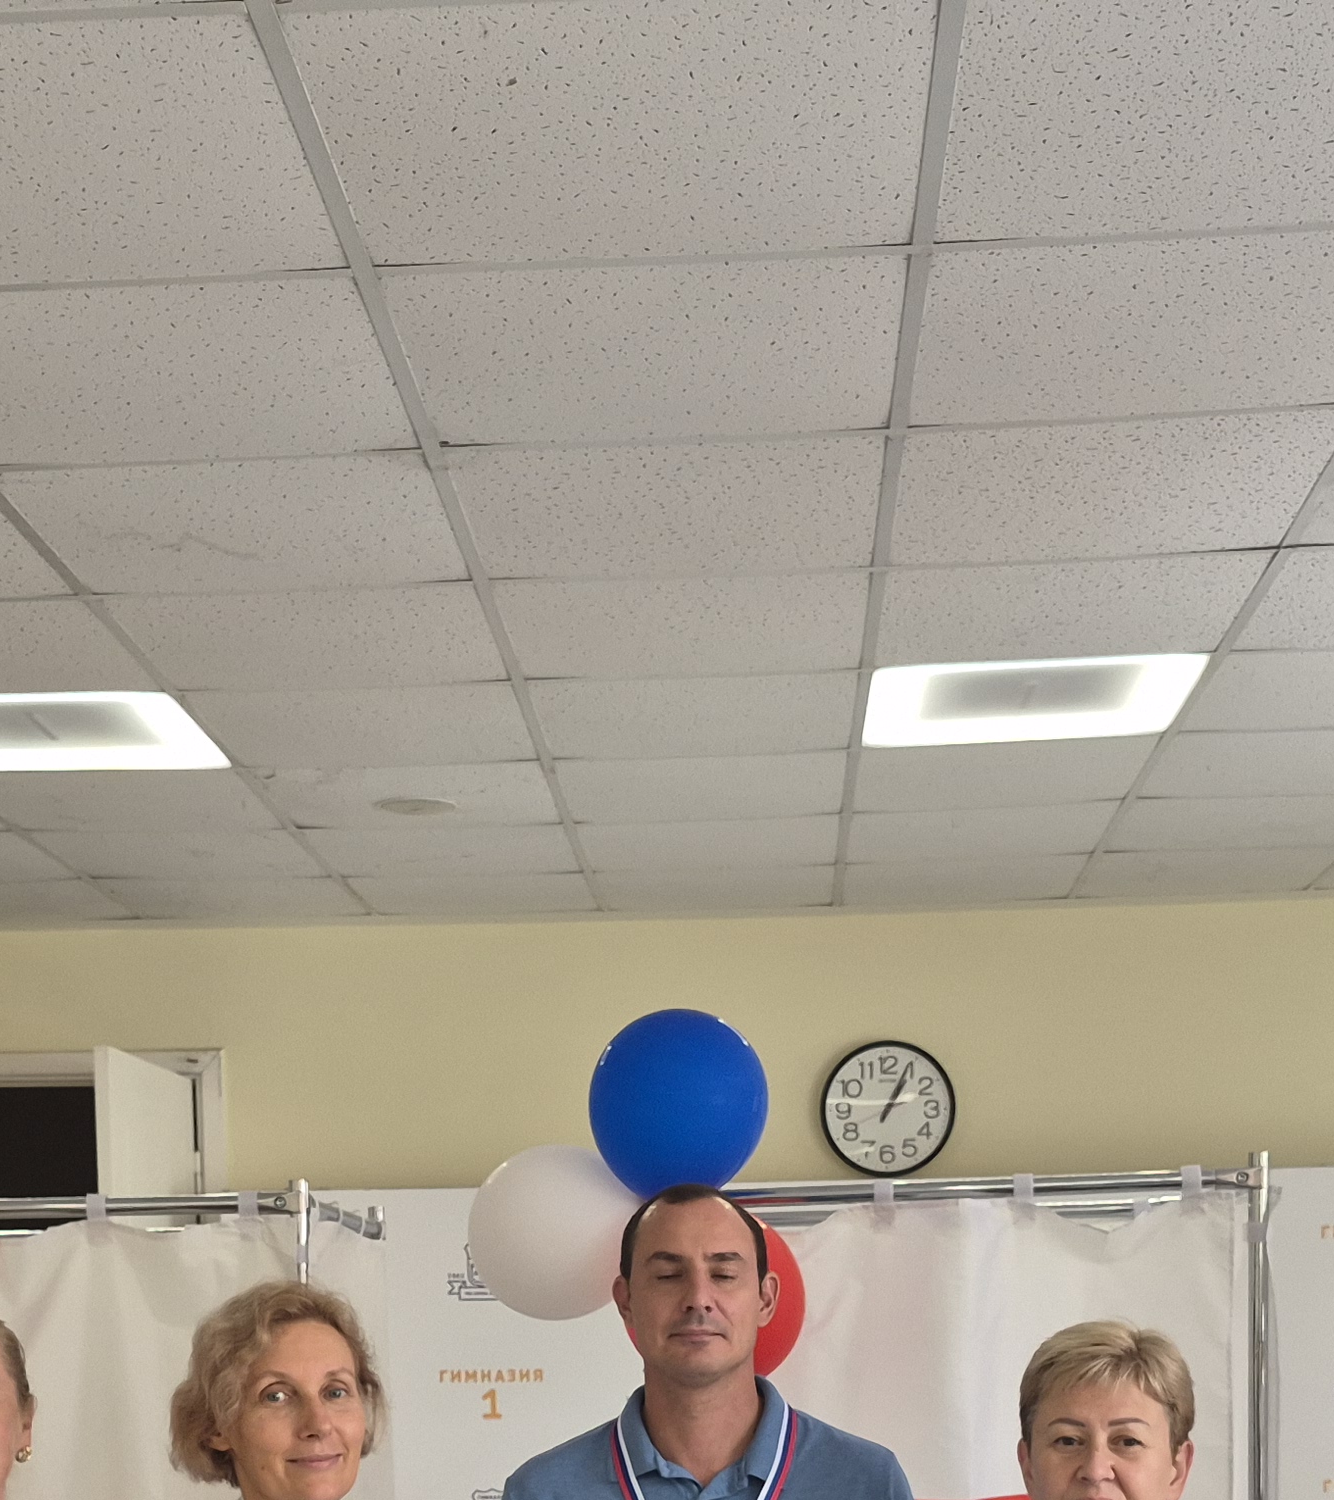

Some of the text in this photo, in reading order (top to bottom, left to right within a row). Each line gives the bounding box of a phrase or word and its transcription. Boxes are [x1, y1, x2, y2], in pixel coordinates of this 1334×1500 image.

[858, 1061, 874, 1080] 11
[878, 1055, 898, 1075] 12
[836, 1078, 863, 1098] 10
[918, 1076, 934, 1096] 2
[835, 1102, 851, 1120] 9
[923, 1100, 940, 1119] 3
[842, 1122, 859, 1141] 8
[917, 1121, 933, 1140] 4
[860, 1140, 876, 1160] 7
[879, 1144, 896, 1164] 6
[901, 1138, 917, 1158] 5
[439, 1368, 545, 1384] ГИМНАЗИЯ
[482, 1389, 503, 1420] 1
